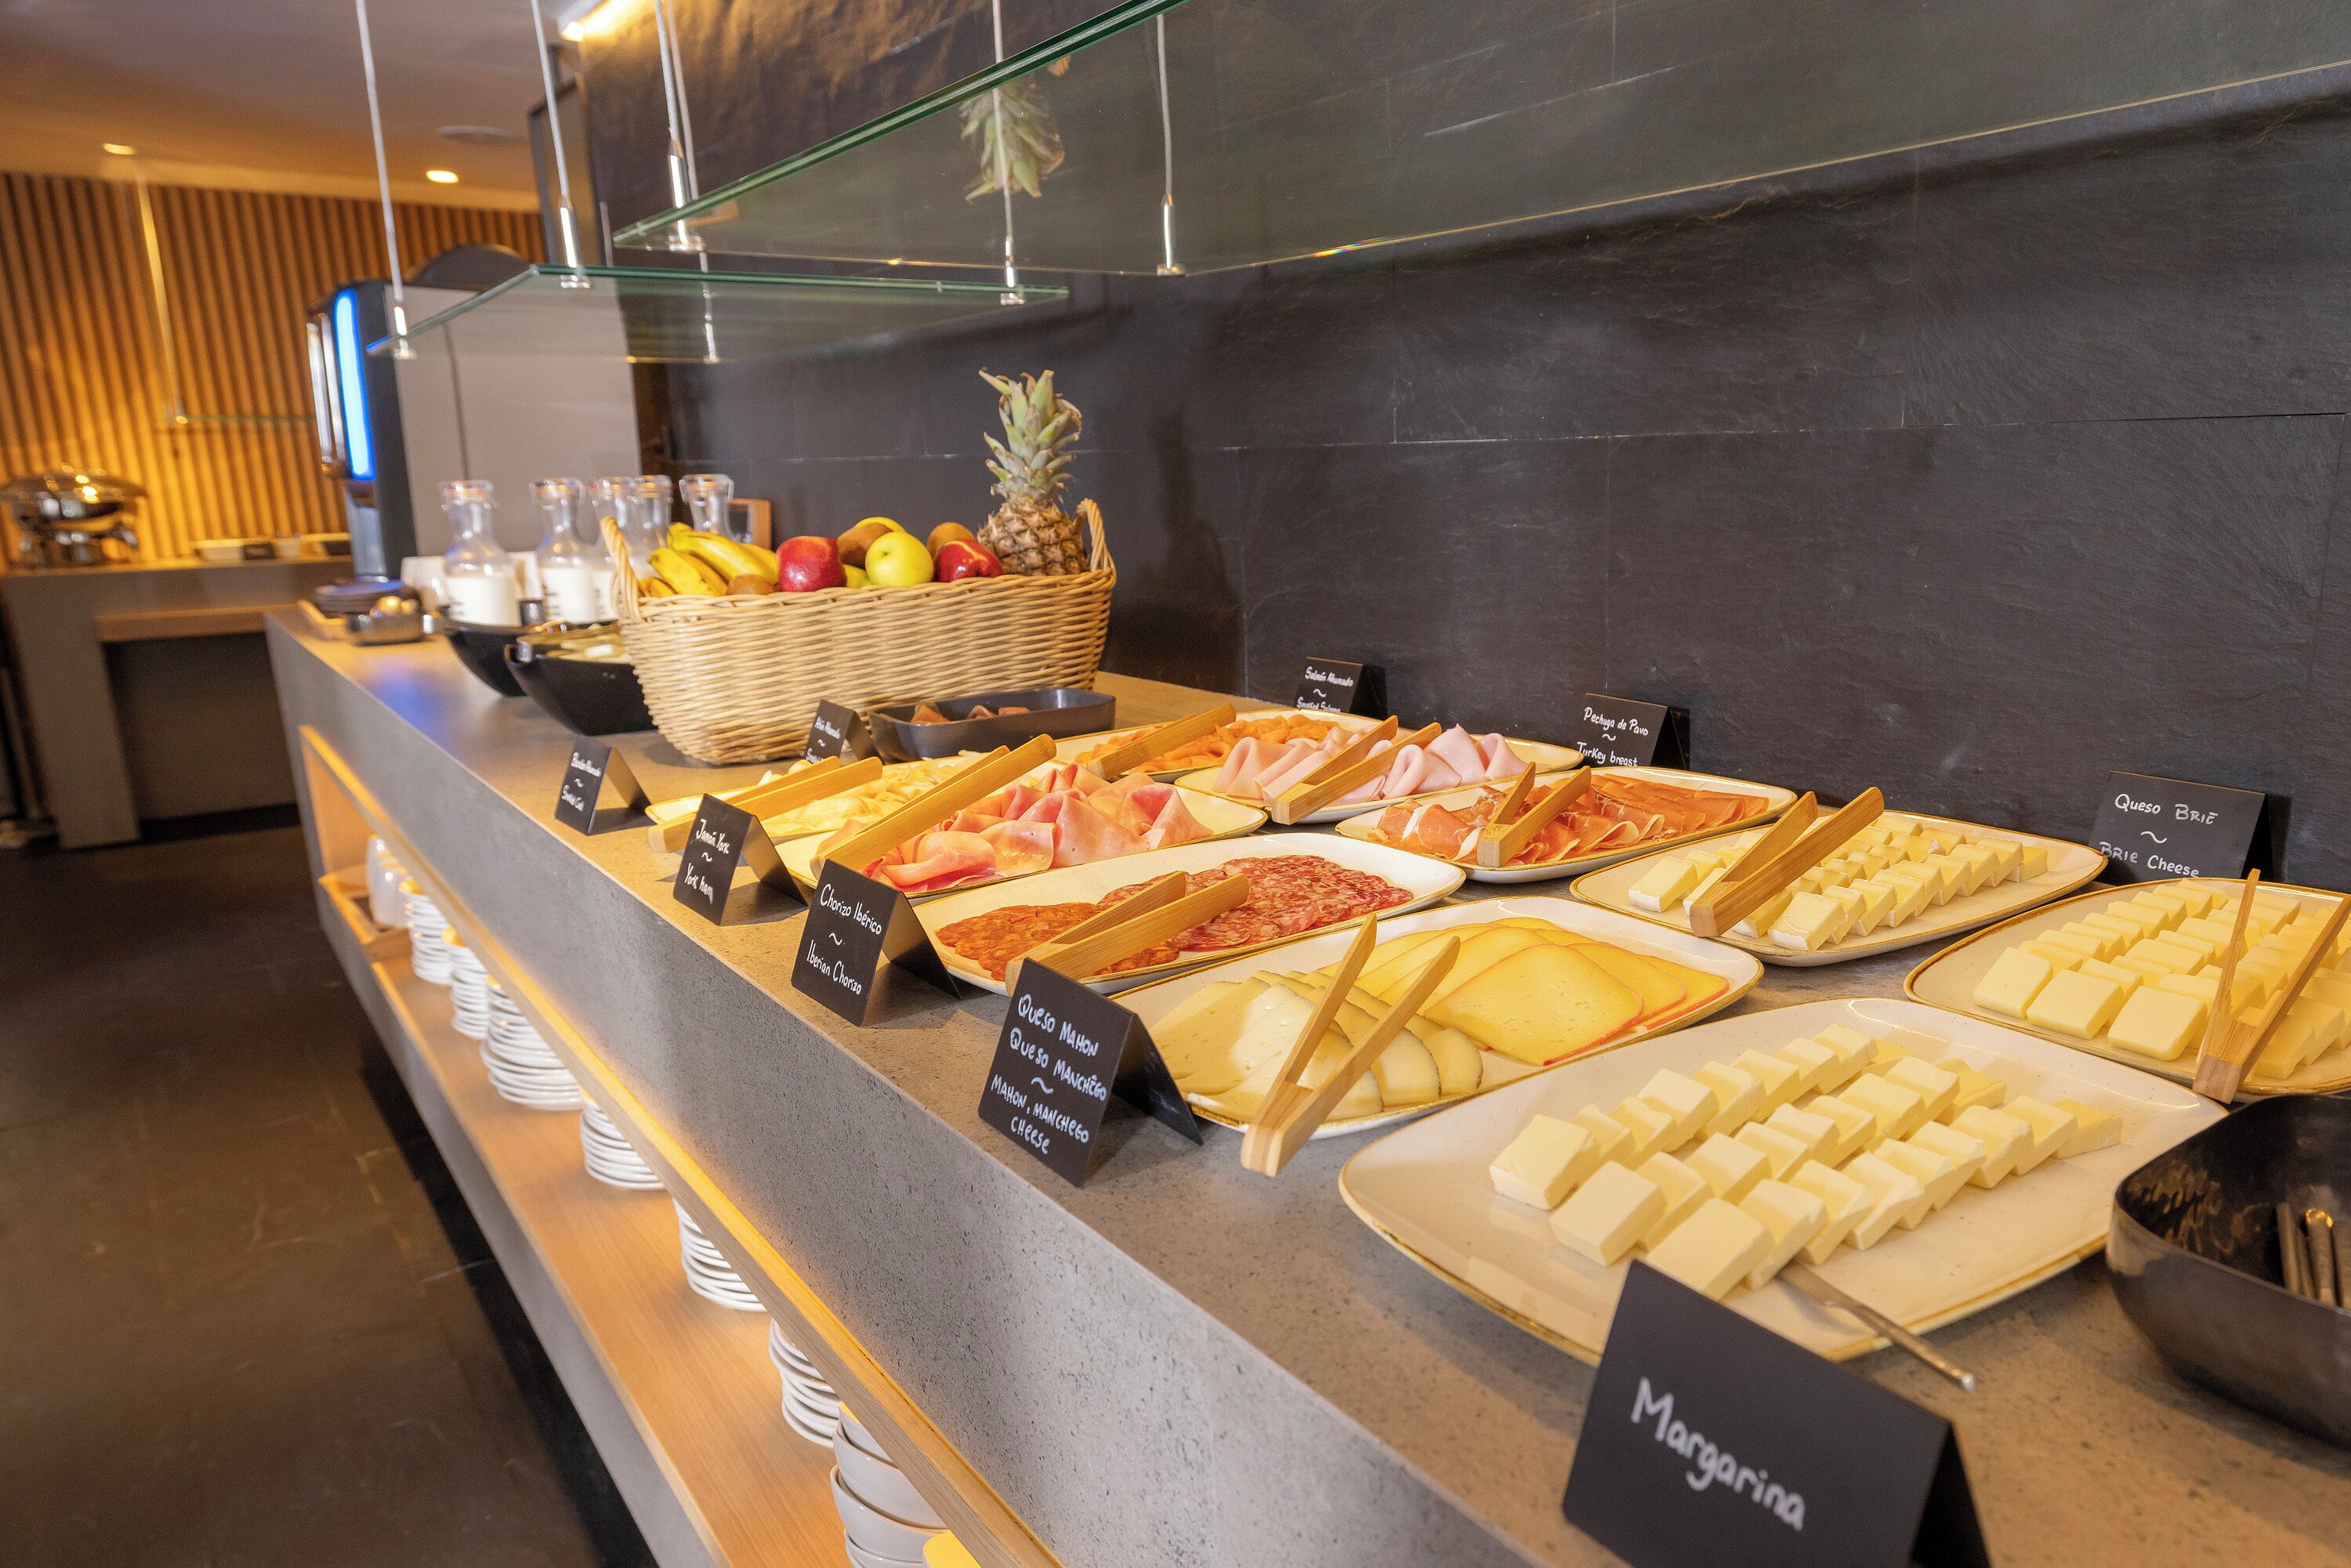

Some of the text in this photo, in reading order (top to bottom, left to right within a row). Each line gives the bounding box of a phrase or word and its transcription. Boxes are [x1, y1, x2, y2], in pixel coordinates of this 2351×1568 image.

[1305, 666, 1354, 687] Salmón Ahumado
[1583, 707, 1649, 736] Pechuga de Pavo
[1610, 751, 1638, 766] breast
[2115, 794, 2161, 814] Queso
[2147, 855, 2199, 878] Cheese
[699, 875, 714, 905] ham
[820, 884, 882, 935] Chorizo Ibérico
[806, 940, 862, 995] Iberian Chorizo
[1059, 1021, 1099, 1056] MAHON
[1630, 1376, 1806, 1530] Margarina
